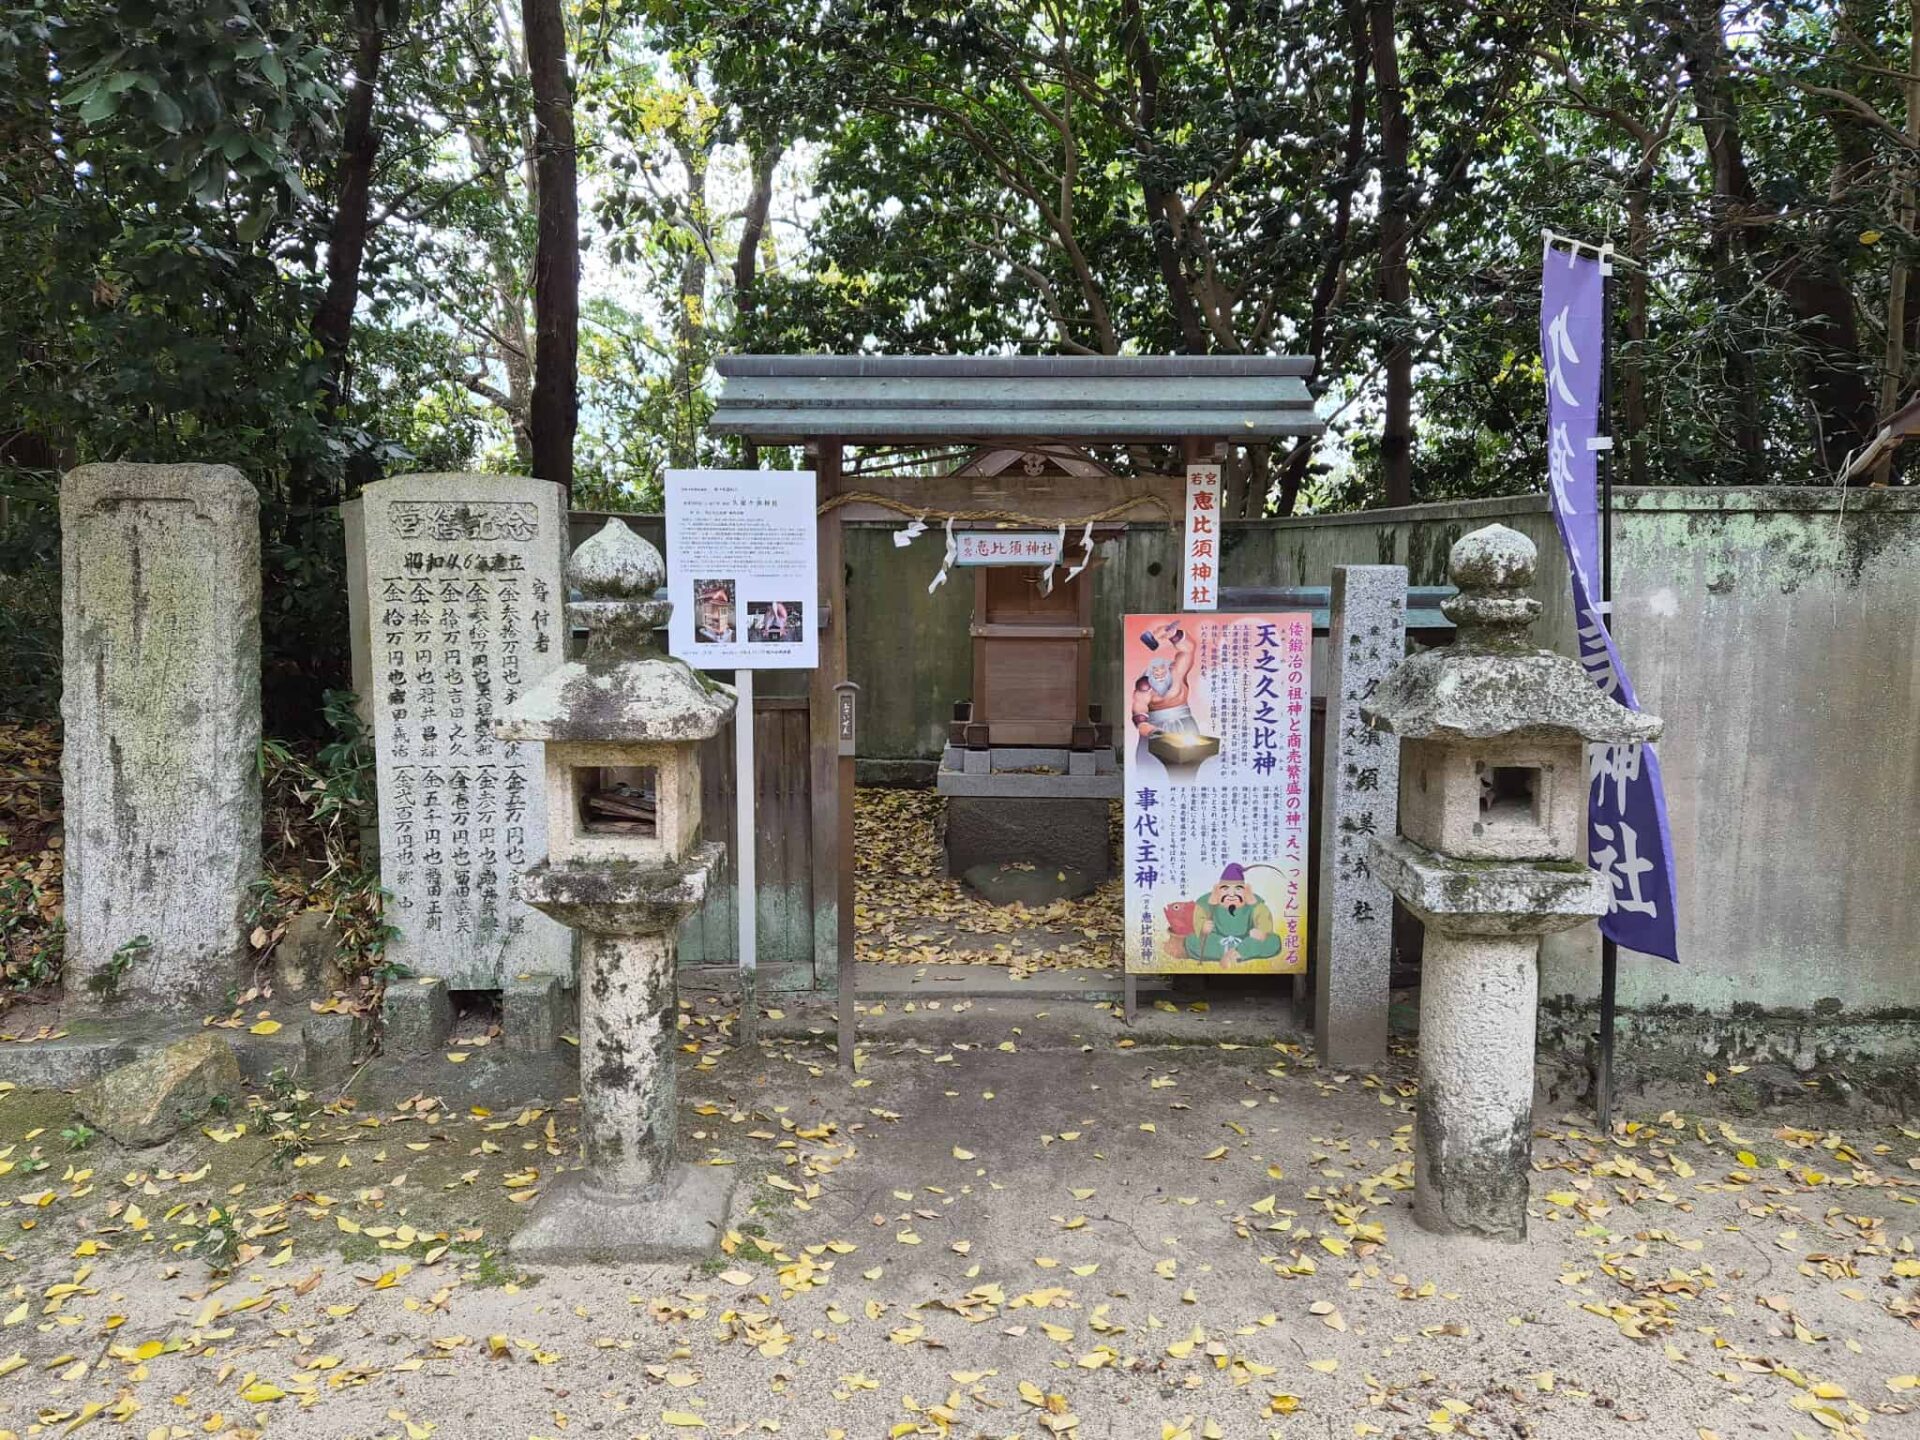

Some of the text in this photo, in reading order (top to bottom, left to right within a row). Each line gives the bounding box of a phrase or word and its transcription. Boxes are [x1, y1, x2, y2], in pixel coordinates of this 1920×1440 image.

[1190, 472, 1217, 485] 若宮
[1190, 490, 1214, 604] 恵比須神社
[1252, 624, 1280, 776] 天之久之比神
[1133, 787, 1160, 890] 事代主神
